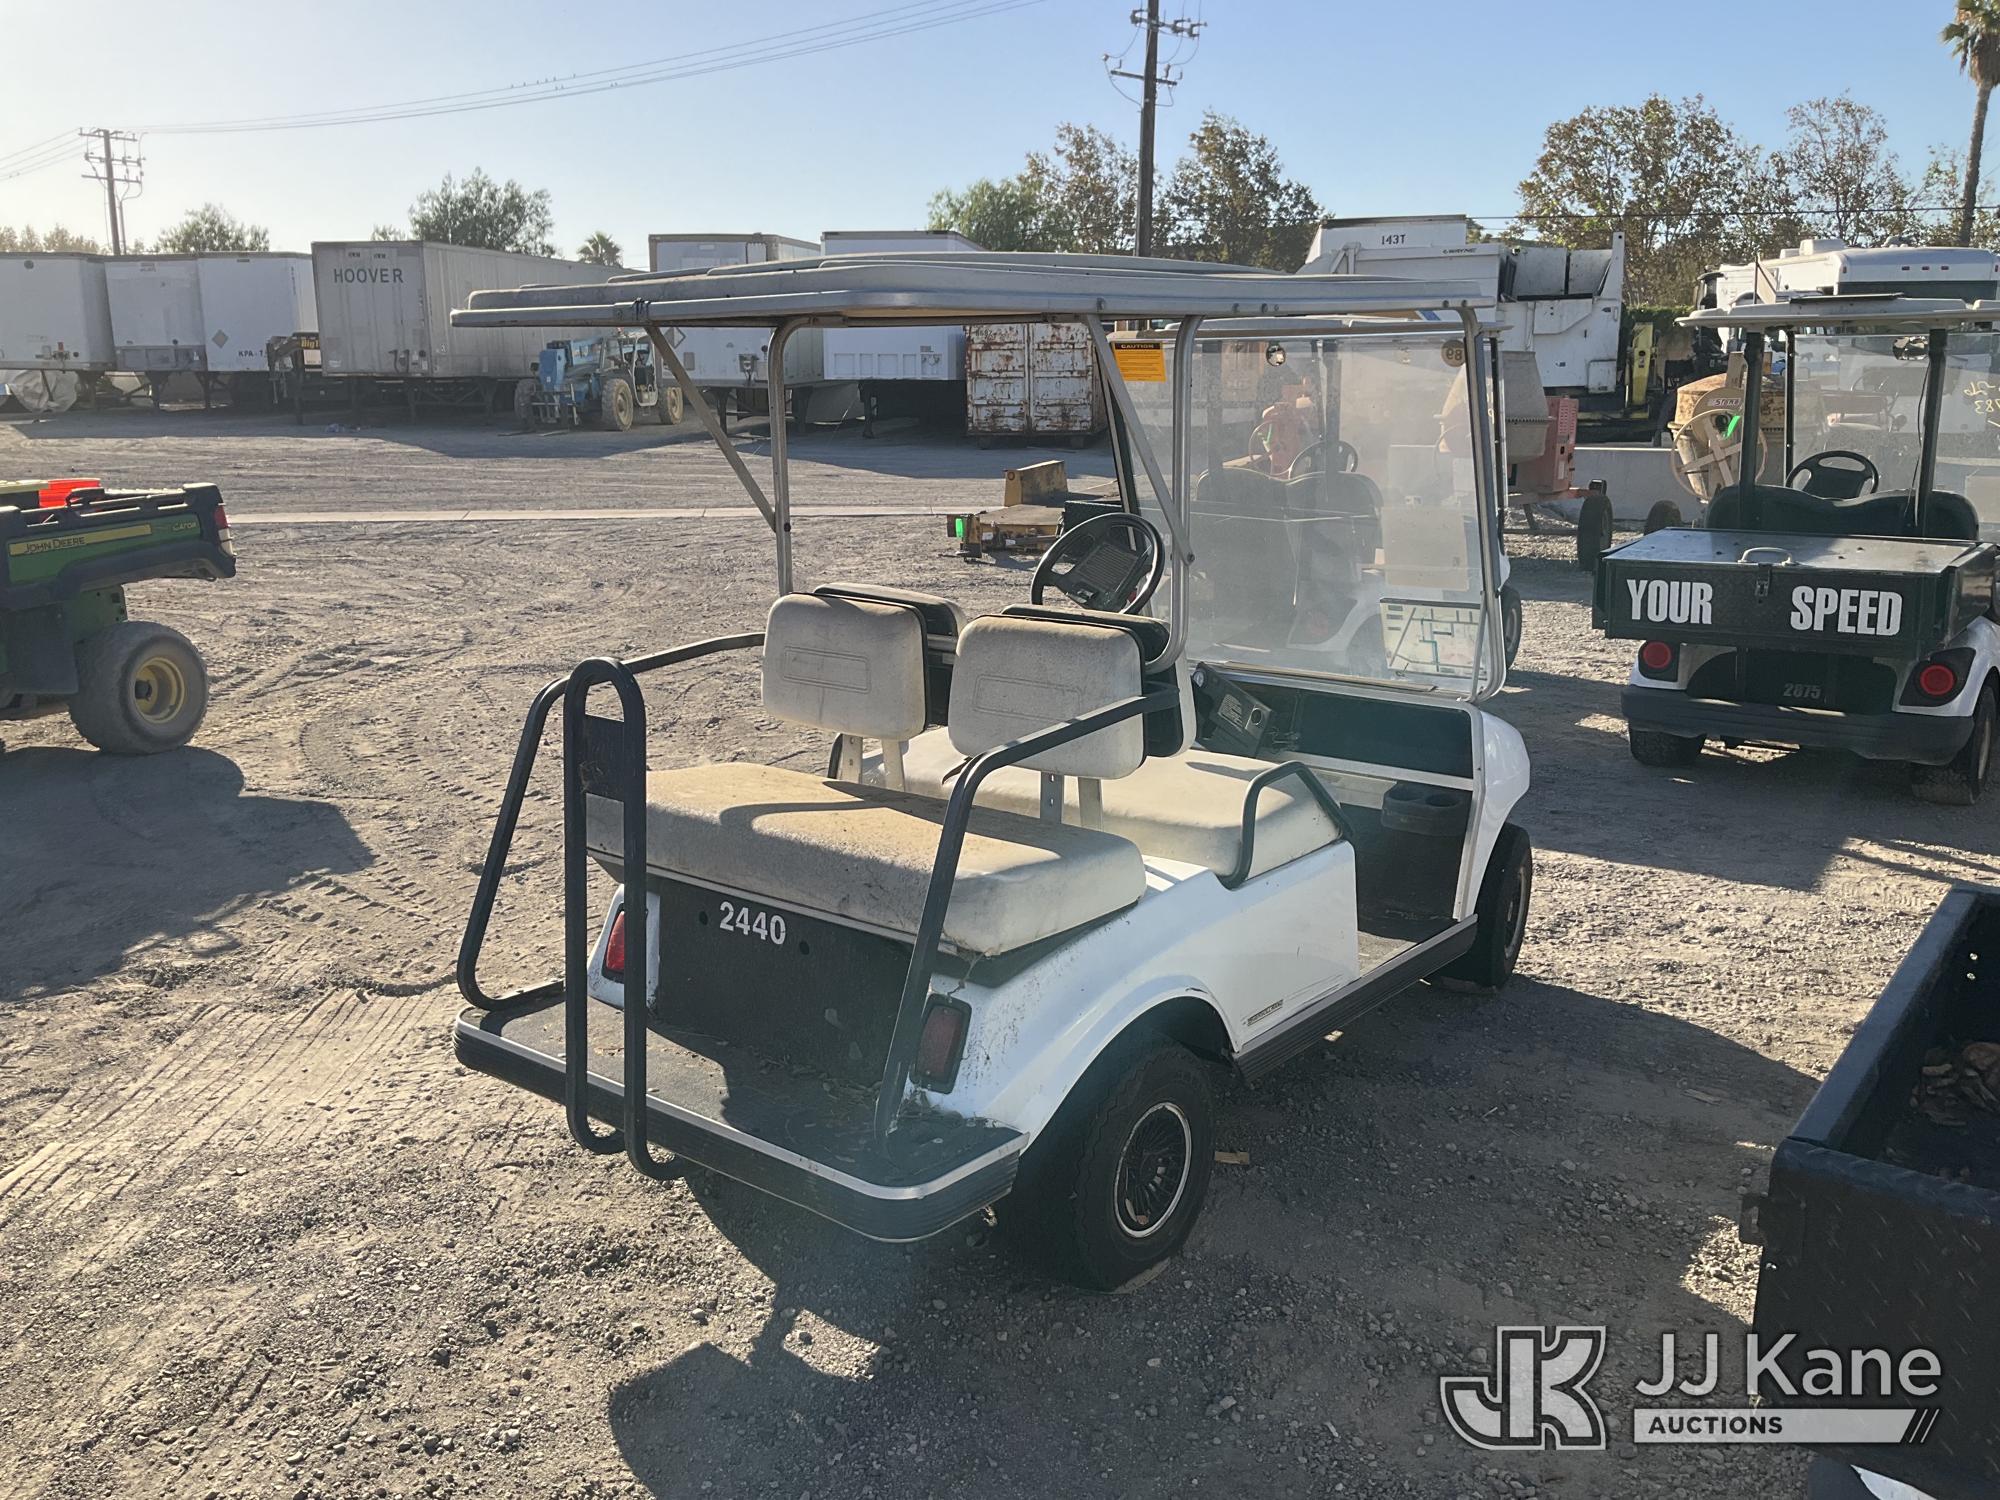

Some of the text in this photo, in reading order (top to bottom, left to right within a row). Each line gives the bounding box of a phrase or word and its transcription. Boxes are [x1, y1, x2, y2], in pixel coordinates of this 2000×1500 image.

[1381, 234, 1406, 245] 143T
[333, 268, 404, 283] HOOVER
[25, 536, 86, 554] JOHN DEERE
[1627, 578, 1903, 637] YOUR SPEED
[719, 901, 786, 945] 2440
